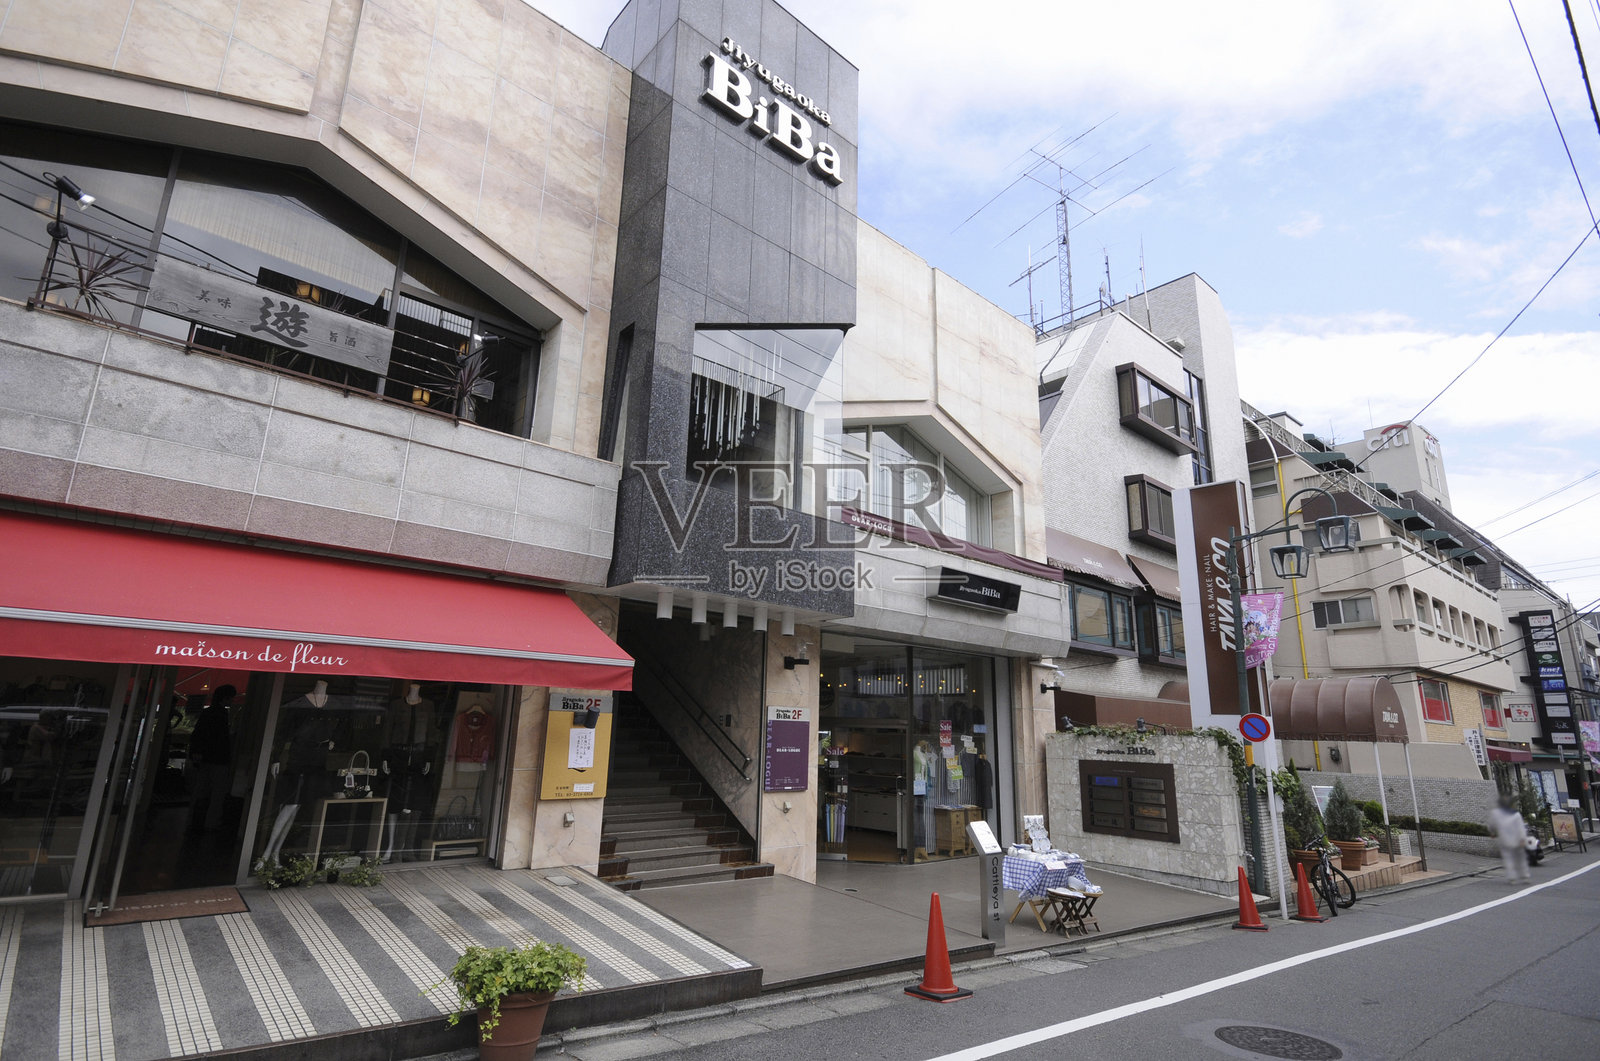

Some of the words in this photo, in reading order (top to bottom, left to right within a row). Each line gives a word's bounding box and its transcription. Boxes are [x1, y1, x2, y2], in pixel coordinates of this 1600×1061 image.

[721, 36, 832, 126] Jiyugaoka
[701, 51, 844, 185] BiBa
[195, 289, 232, 309] 美味
[250, 296, 309, 348] 遊
[1366, 424, 1410, 452] citi
[981, 586, 1001, 599] BiBa
[1209, 612, 1217, 632] HAIR
[155, 640, 253, 661] maison
[257, 645, 288, 662] de
[290, 642, 349, 672] fleur
[562, 701, 584, 710] BiBa
[792, 709, 803, 720] 2F
[940, 735, 952, 743] Sale
[826, 747, 845, 756] Sale
[1127, 746, 1156, 756] BiBa
[991, 856, 999, 910] Cattleya
